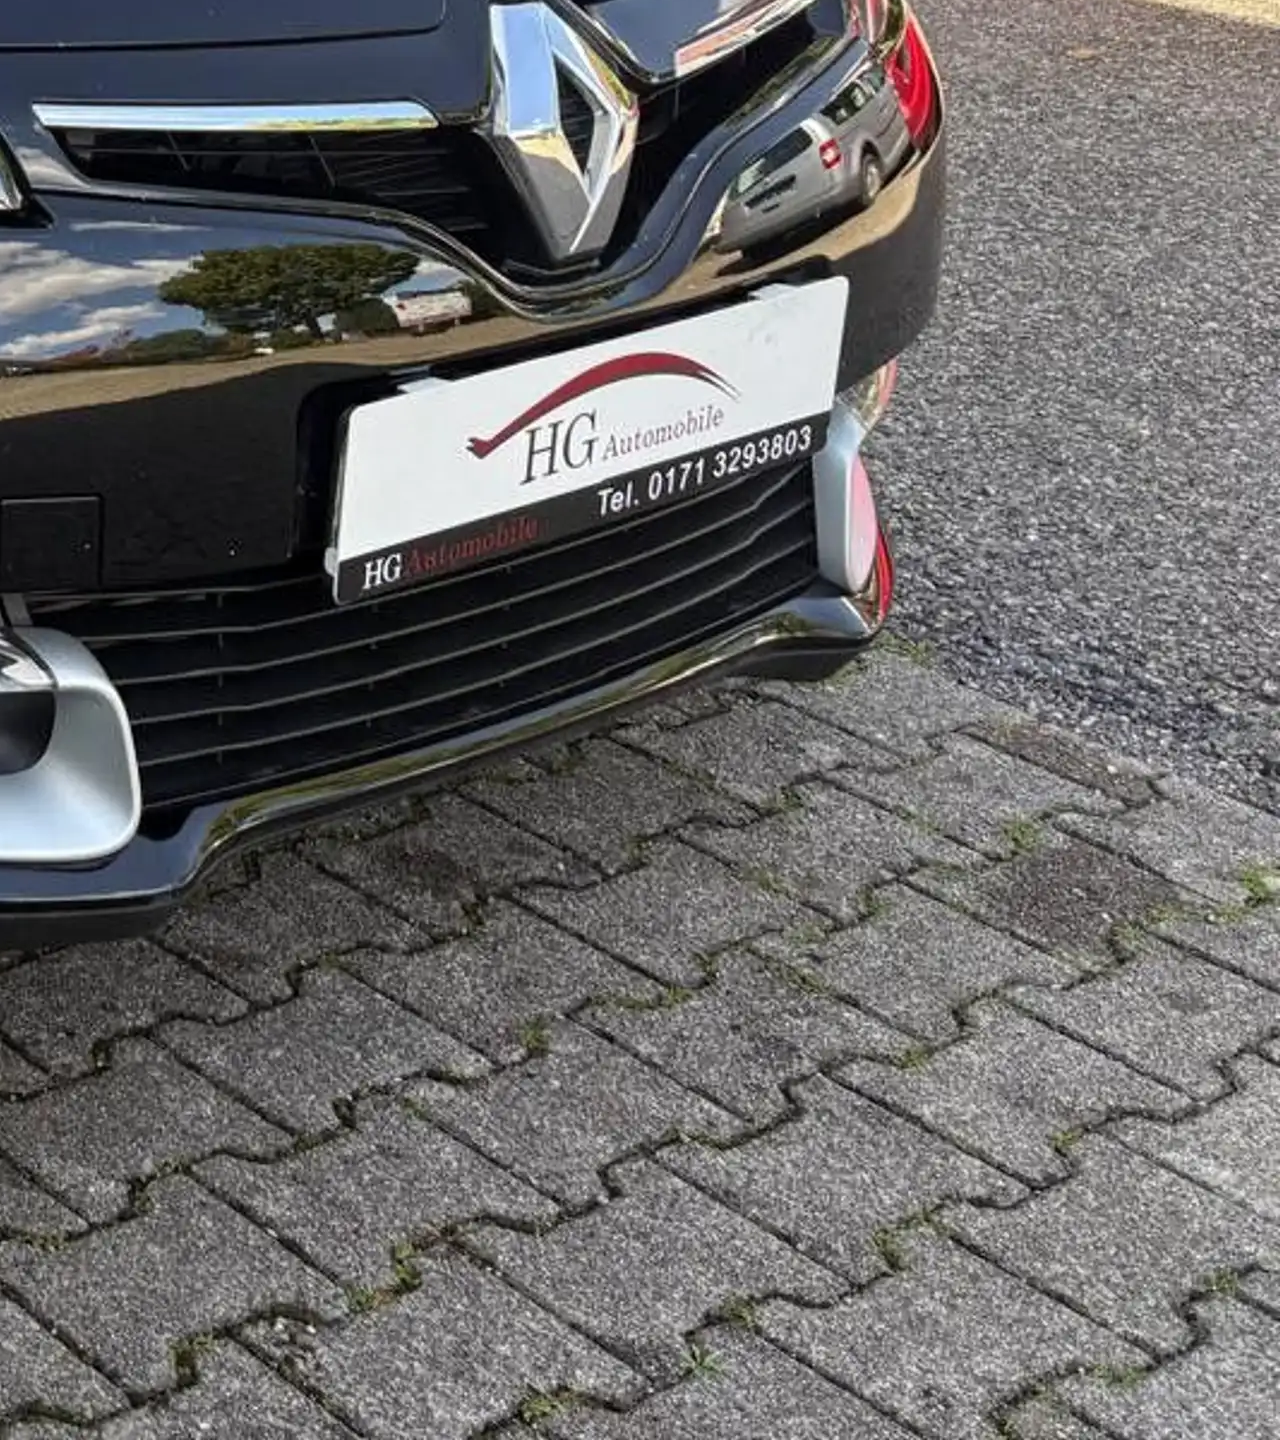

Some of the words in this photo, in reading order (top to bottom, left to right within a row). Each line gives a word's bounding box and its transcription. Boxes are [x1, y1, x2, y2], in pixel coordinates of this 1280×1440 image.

[520, 409, 599, 485] HG
[602, 405, 725, 461] Automobile
[598, 481, 640, 516] Tel.
[648, 456, 705, 501] 0171
[712, 424, 812, 479] 3293803
[362, 552, 403, 590] HG
[405, 516, 539, 575] Automobile
